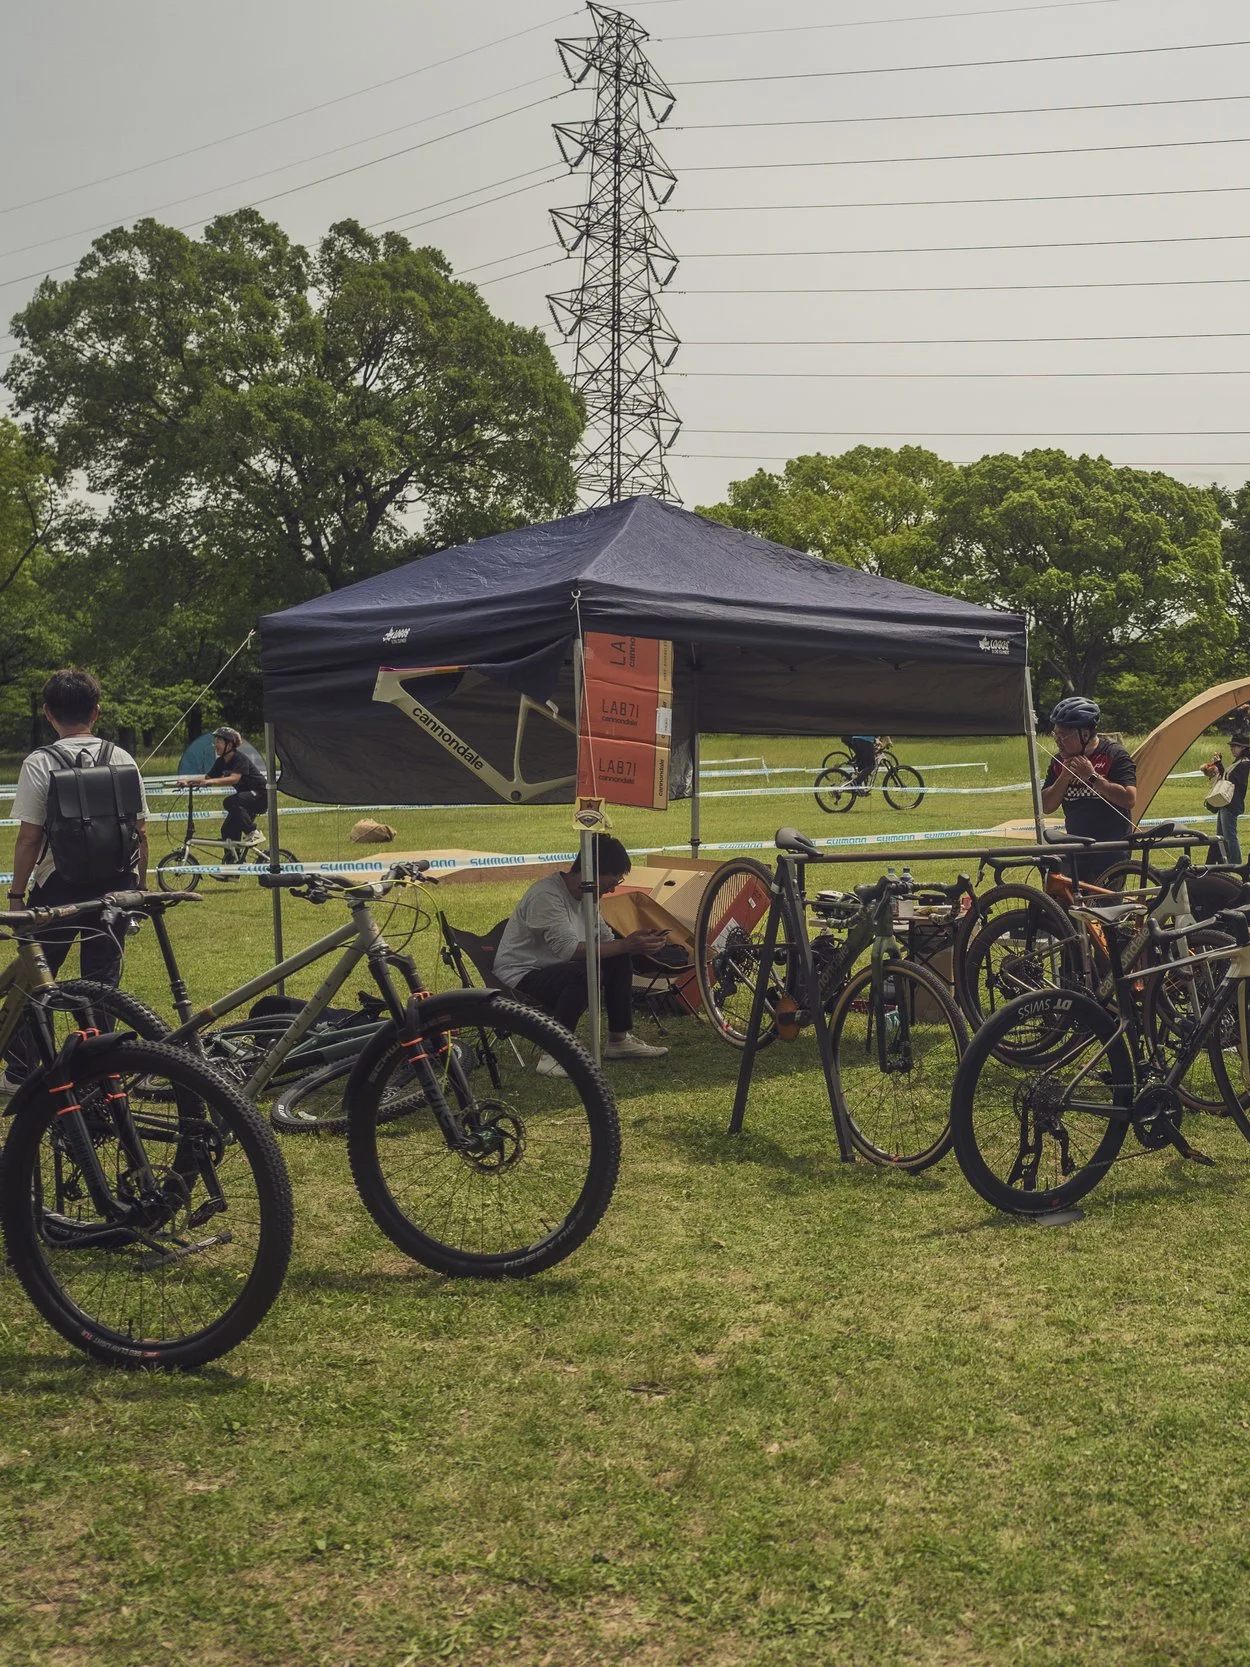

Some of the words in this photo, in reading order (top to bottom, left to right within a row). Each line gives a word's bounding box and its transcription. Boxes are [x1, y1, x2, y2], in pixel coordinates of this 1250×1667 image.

[602, 698, 639, 719] LAB71
[601, 714, 638, 727] cannondale
[413, 707, 484, 771] cannondale
[599, 758, 637, 777] LAB71
[598, 774, 635, 785] cannondale
[826, 837, 867, 846] SHIMANO
[876, 834, 915, 843] SHIMANO
[924, 831, 961, 839] SHIMANO
[320, 861, 383, 872] SHIMANO
[470, 855, 525, 867] SHIMANO
[1017, 998, 1052, 1020] SWISS
[1053, 998, 1073, 1011] DT
